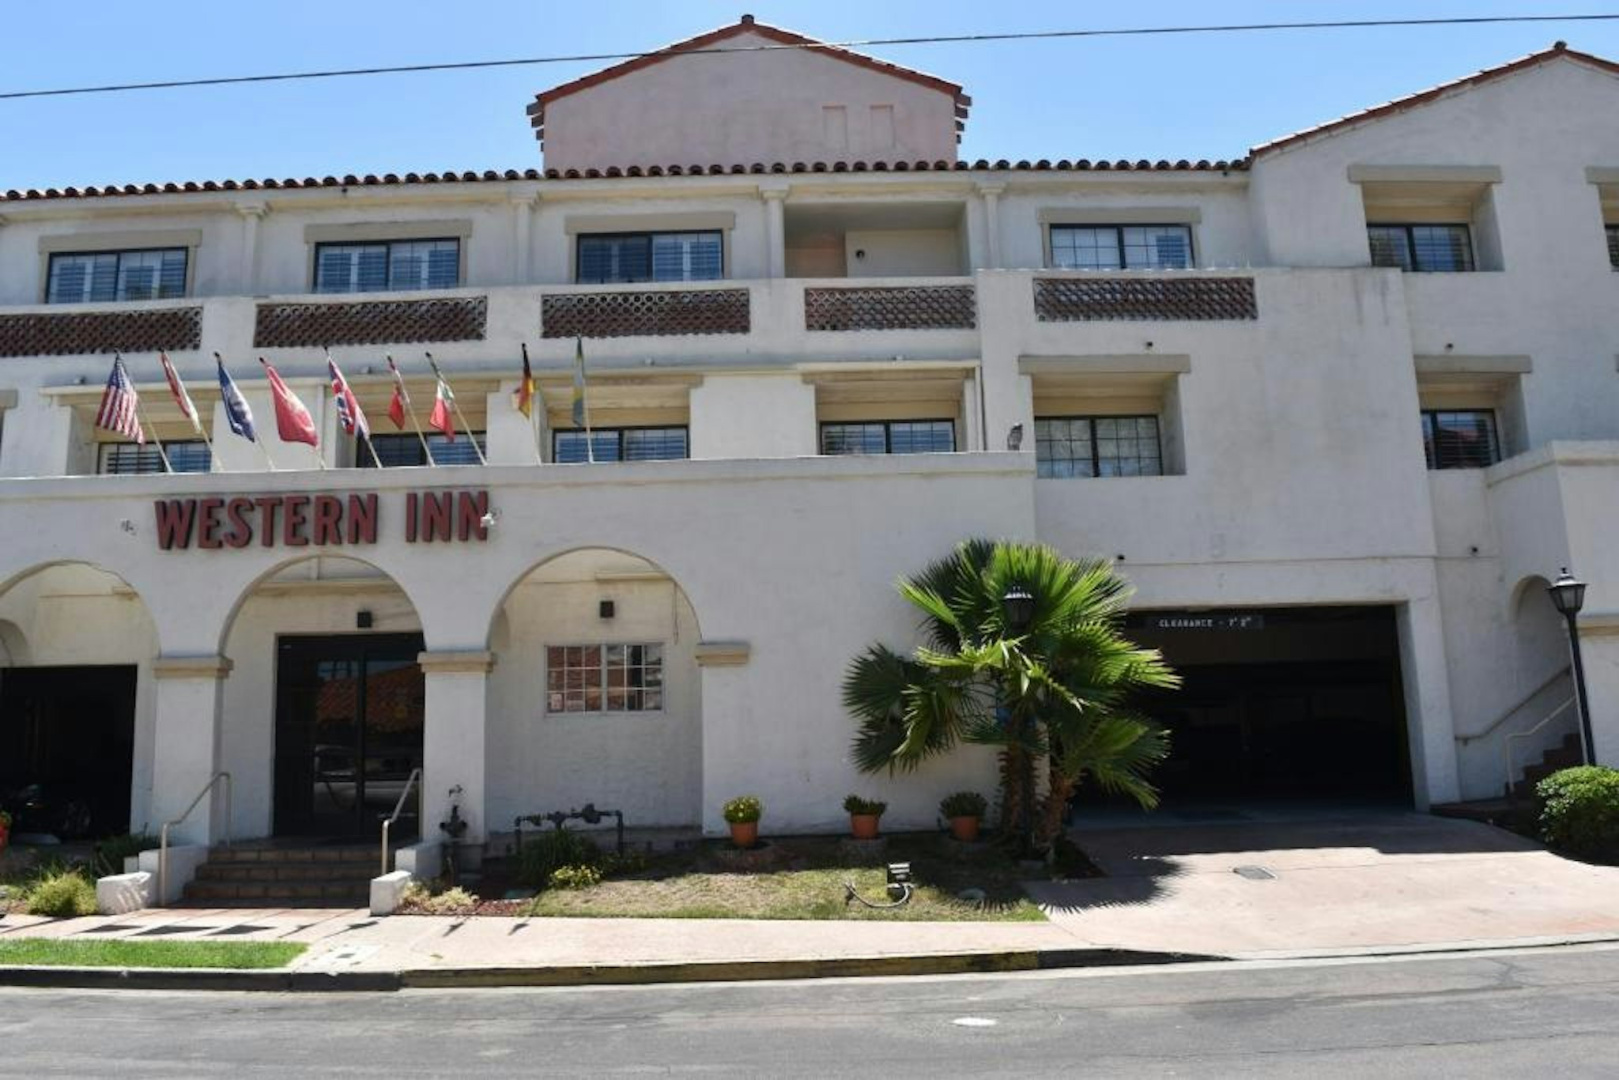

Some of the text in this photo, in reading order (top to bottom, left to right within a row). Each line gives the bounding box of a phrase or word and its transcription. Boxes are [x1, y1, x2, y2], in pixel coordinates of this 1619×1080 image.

[154, 491, 490, 551] WESTERN INN
[1158, 618, 1213, 628] CLEARANCE
